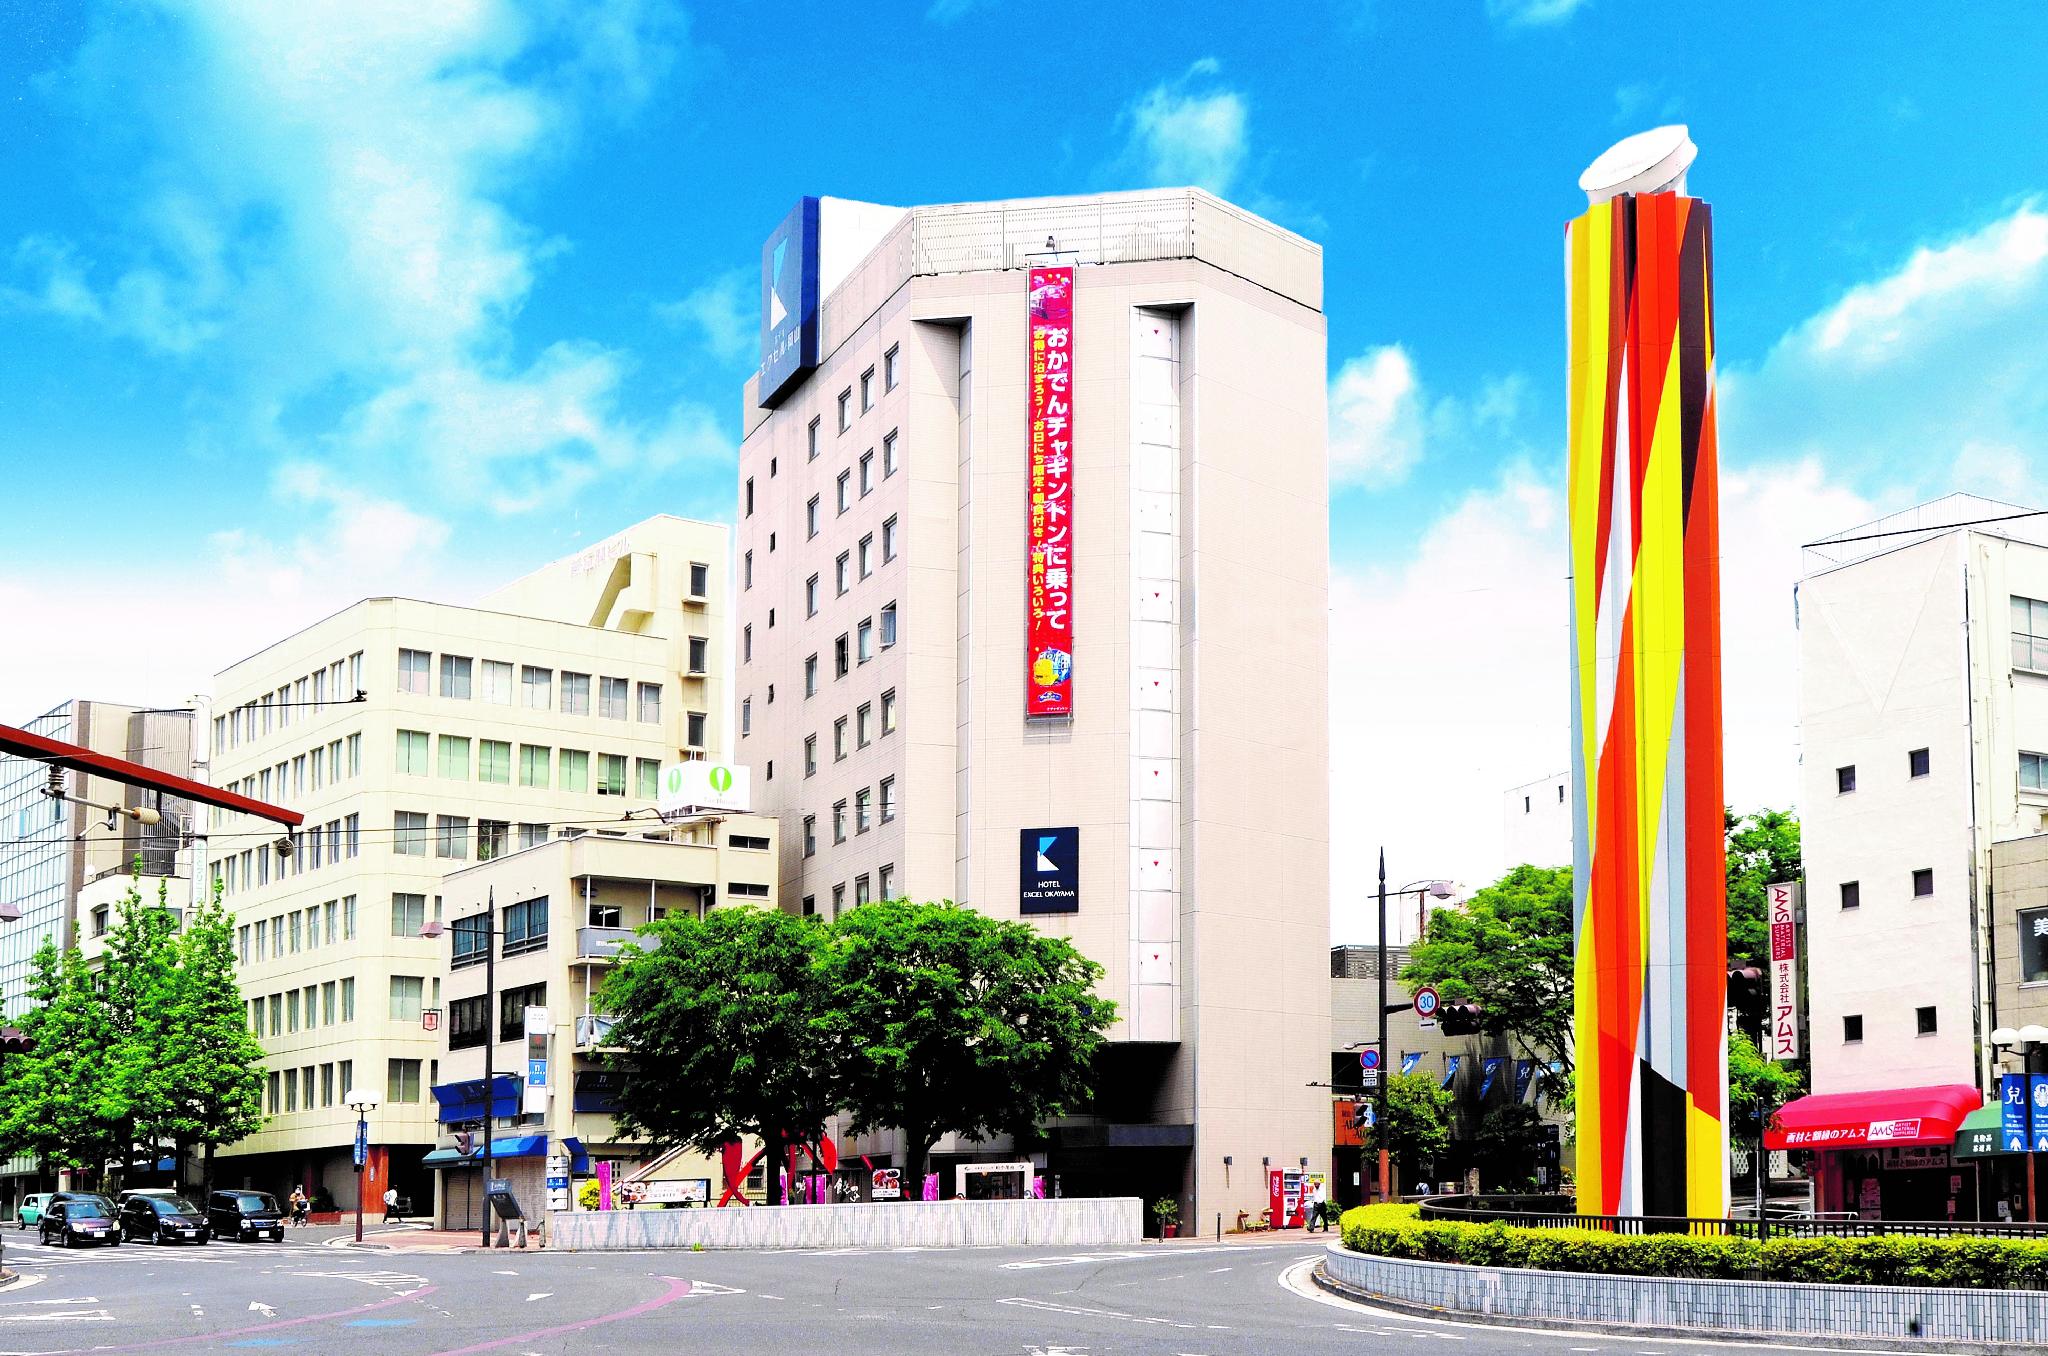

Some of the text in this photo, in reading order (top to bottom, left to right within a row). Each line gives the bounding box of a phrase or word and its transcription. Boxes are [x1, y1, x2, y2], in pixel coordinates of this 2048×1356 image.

[1046, 328, 1069, 630] おかでんチャギントンに乗って
[1774, 888, 1790, 923] AMS
[1420, 996, 1433, 1008] 30
[1869, 1124, 1894, 1136] AMS
